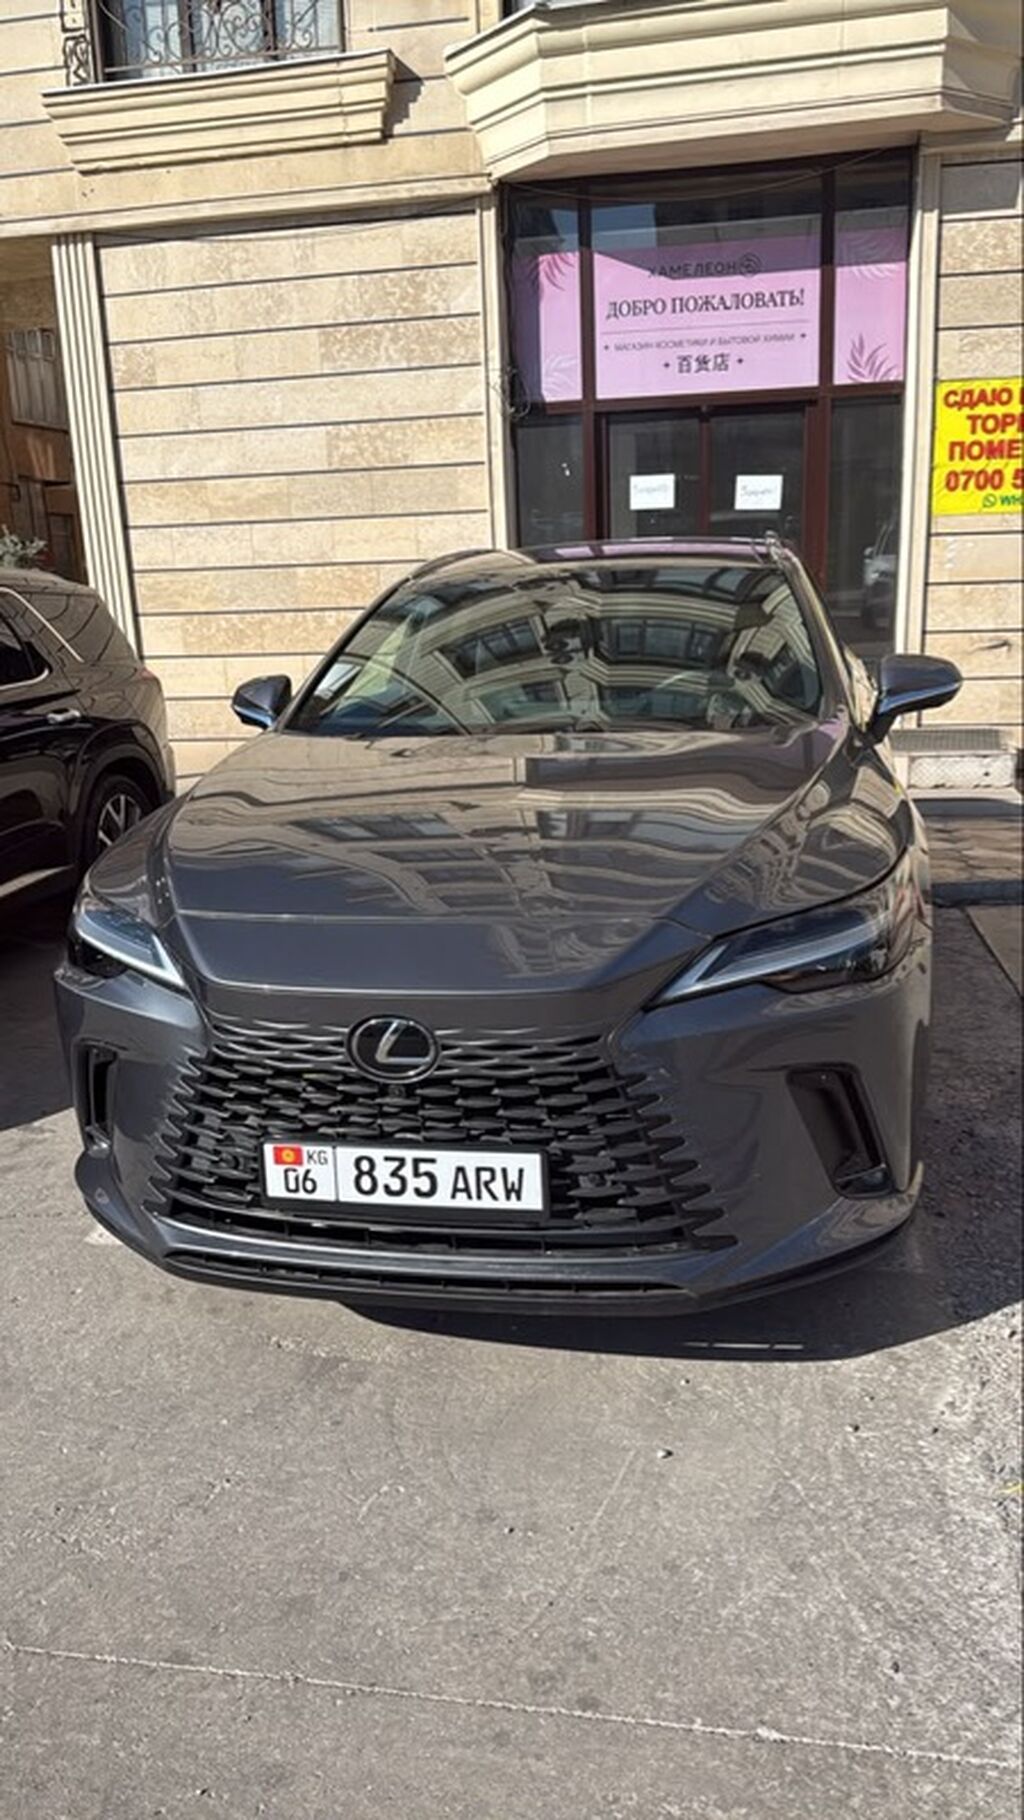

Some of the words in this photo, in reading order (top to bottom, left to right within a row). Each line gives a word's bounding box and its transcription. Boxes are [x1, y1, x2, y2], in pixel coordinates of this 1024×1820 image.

[648, 262, 738, 279] ХАМЕЛЕОН
[606, 298, 667, 320] ДОБРО
[671, 288, 806, 315] ПОЖАЛОВАТЬ!
[676, 353, 731, 375] 百货店
[943, 387, 1013, 411] СДАЮ
[948, 438, 1022, 462] ПОМЕ
[945, 468, 1005, 492] 0700
[306, 1149, 328, 1166] KG
[283, 1167, 317, 1194] 06
[353, 1155, 438, 1199] 835
[450, 1165, 524, 1202] ARW
